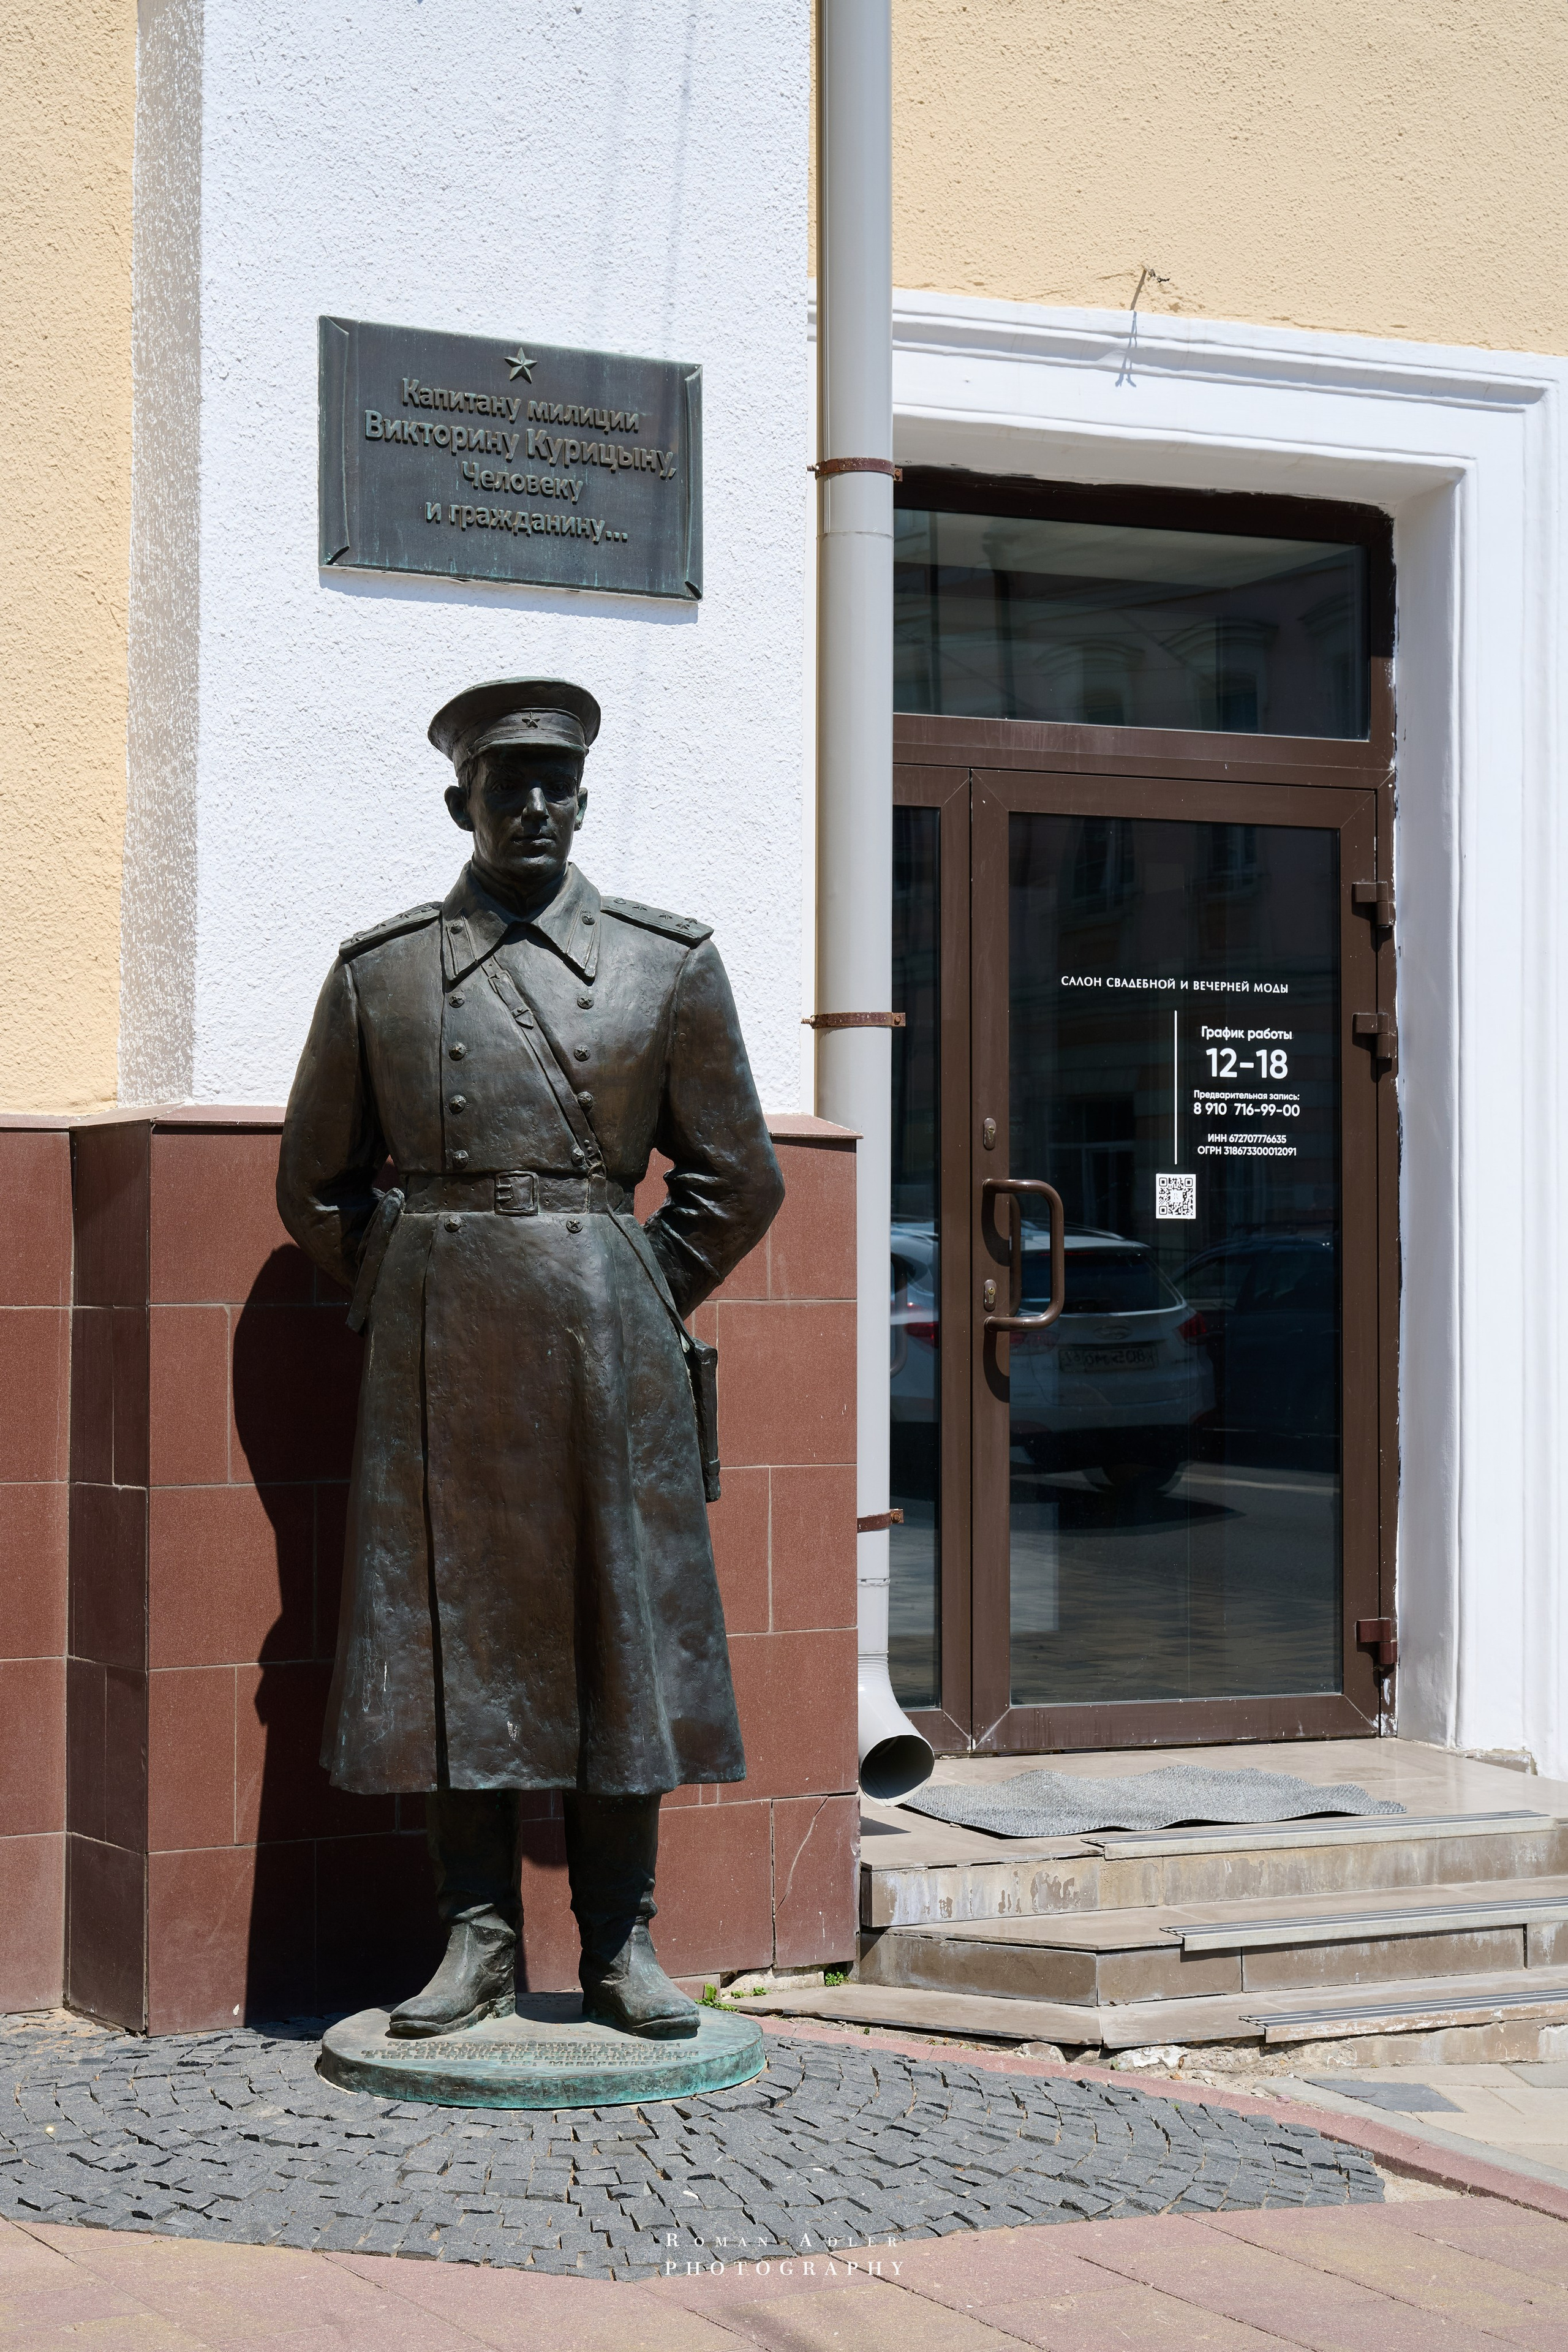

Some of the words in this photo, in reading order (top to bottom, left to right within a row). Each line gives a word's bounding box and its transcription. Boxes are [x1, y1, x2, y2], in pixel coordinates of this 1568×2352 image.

[402, 377, 522, 422] Капитану
[528, 400, 639, 434] милиции
[365, 410, 520, 460] Викторину
[527, 428, 677, 478] Курицыну,
[462, 461, 584, 503] Человеку
[426, 502, 441, 524] и
[450, 504, 628, 544] гражданину...
[1061, 976, 1102, 987] САЛОН
[1106, 977, 1175, 990] СВАДЕБНОЙ
[1180, 980, 1188, 990] И
[1193, 981, 1250, 993] ВЕЧЕРНЕЙ
[1253, 982, 1289, 993] МОДЫ
[1201, 1025, 1245, 1041] График
[1247, 1027, 1292, 1041] работы
[1205, 1047, 1288, 1079] 12-18
[1194, 1089, 1268, 1101] Предварительная
[1268, 1092, 1300, 1101] запись:
[1193, 1102, 1202, 1115] 8
[1205, 1102, 1227, 1116] 910
[1234, 1103, 1300, 1117] 716-99-00
[1207, 1133, 1227, 1143] ИНН
[1229, 1134, 1287, 1144] 672707776635
[1197, 1145, 1222, 1155] ОГРН
[1223, 1146, 1297, 1156] 318673300012091
